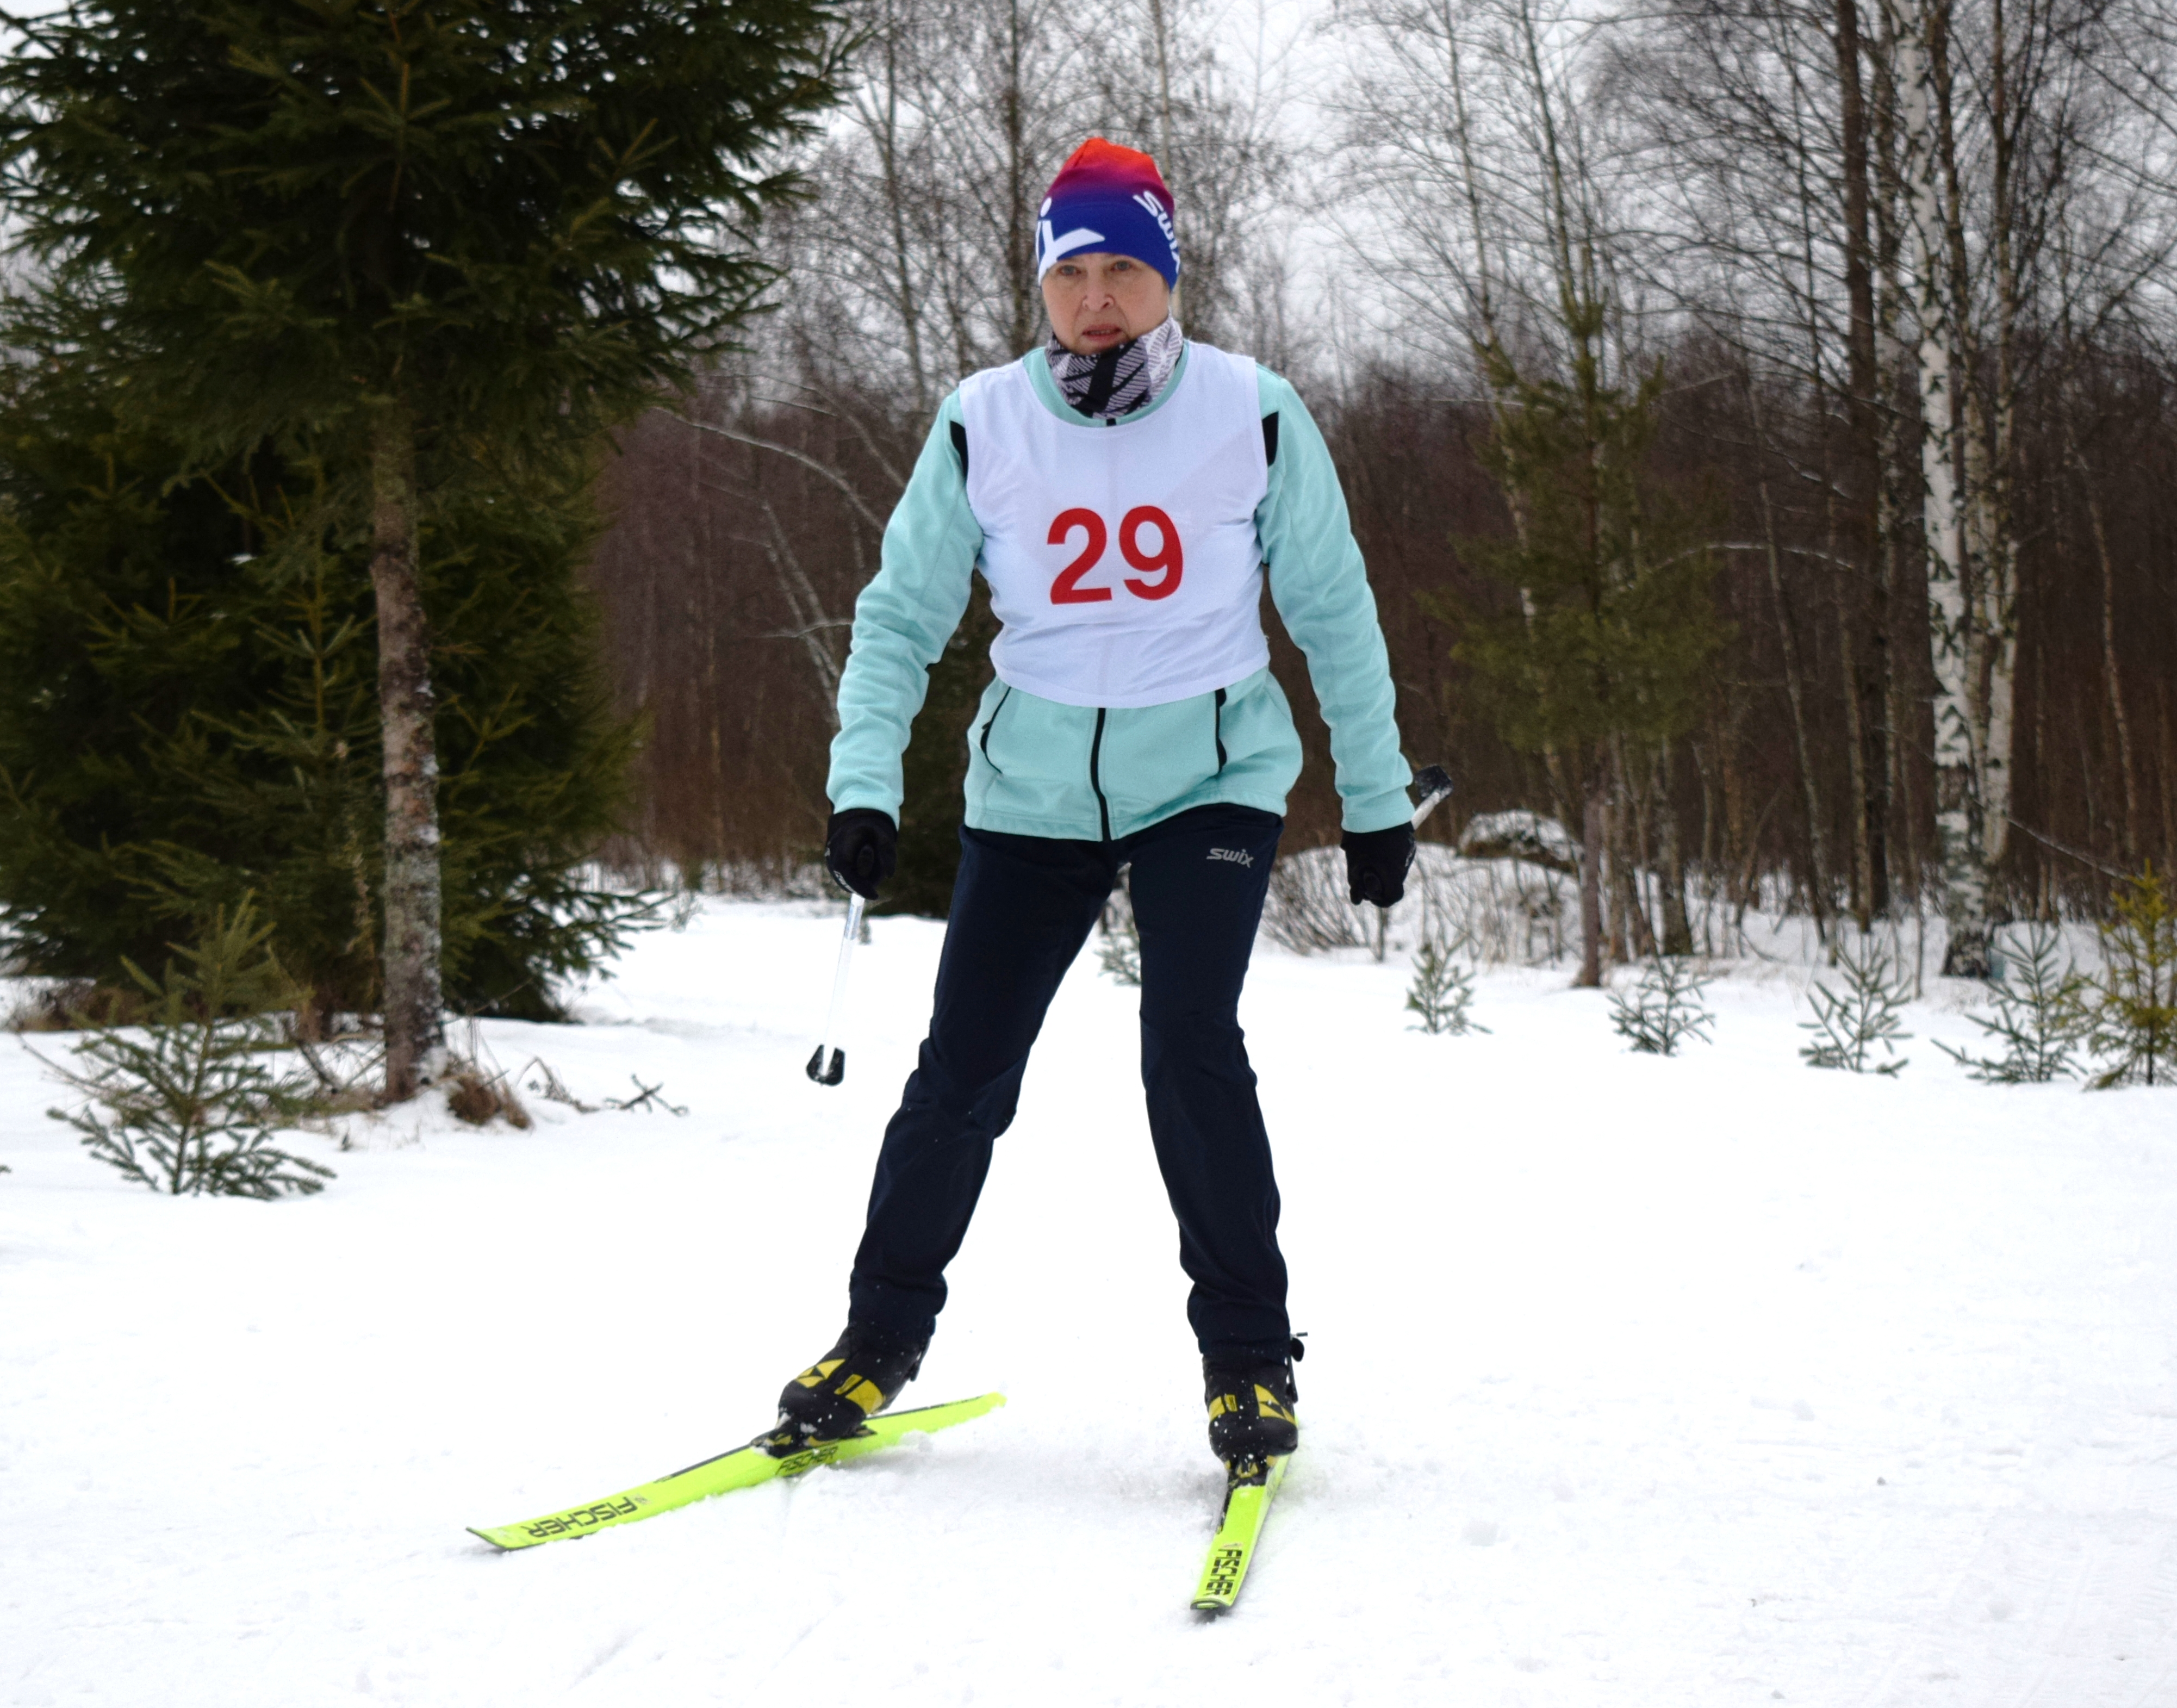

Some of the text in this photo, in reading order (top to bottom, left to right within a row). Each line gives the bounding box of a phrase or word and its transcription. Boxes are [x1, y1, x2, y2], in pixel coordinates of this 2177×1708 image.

[1047, 505, 1184, 605] 29
[520, 1496, 638, 1538] FISCHER
[1203, 1549, 1242, 1595] FISCHER
